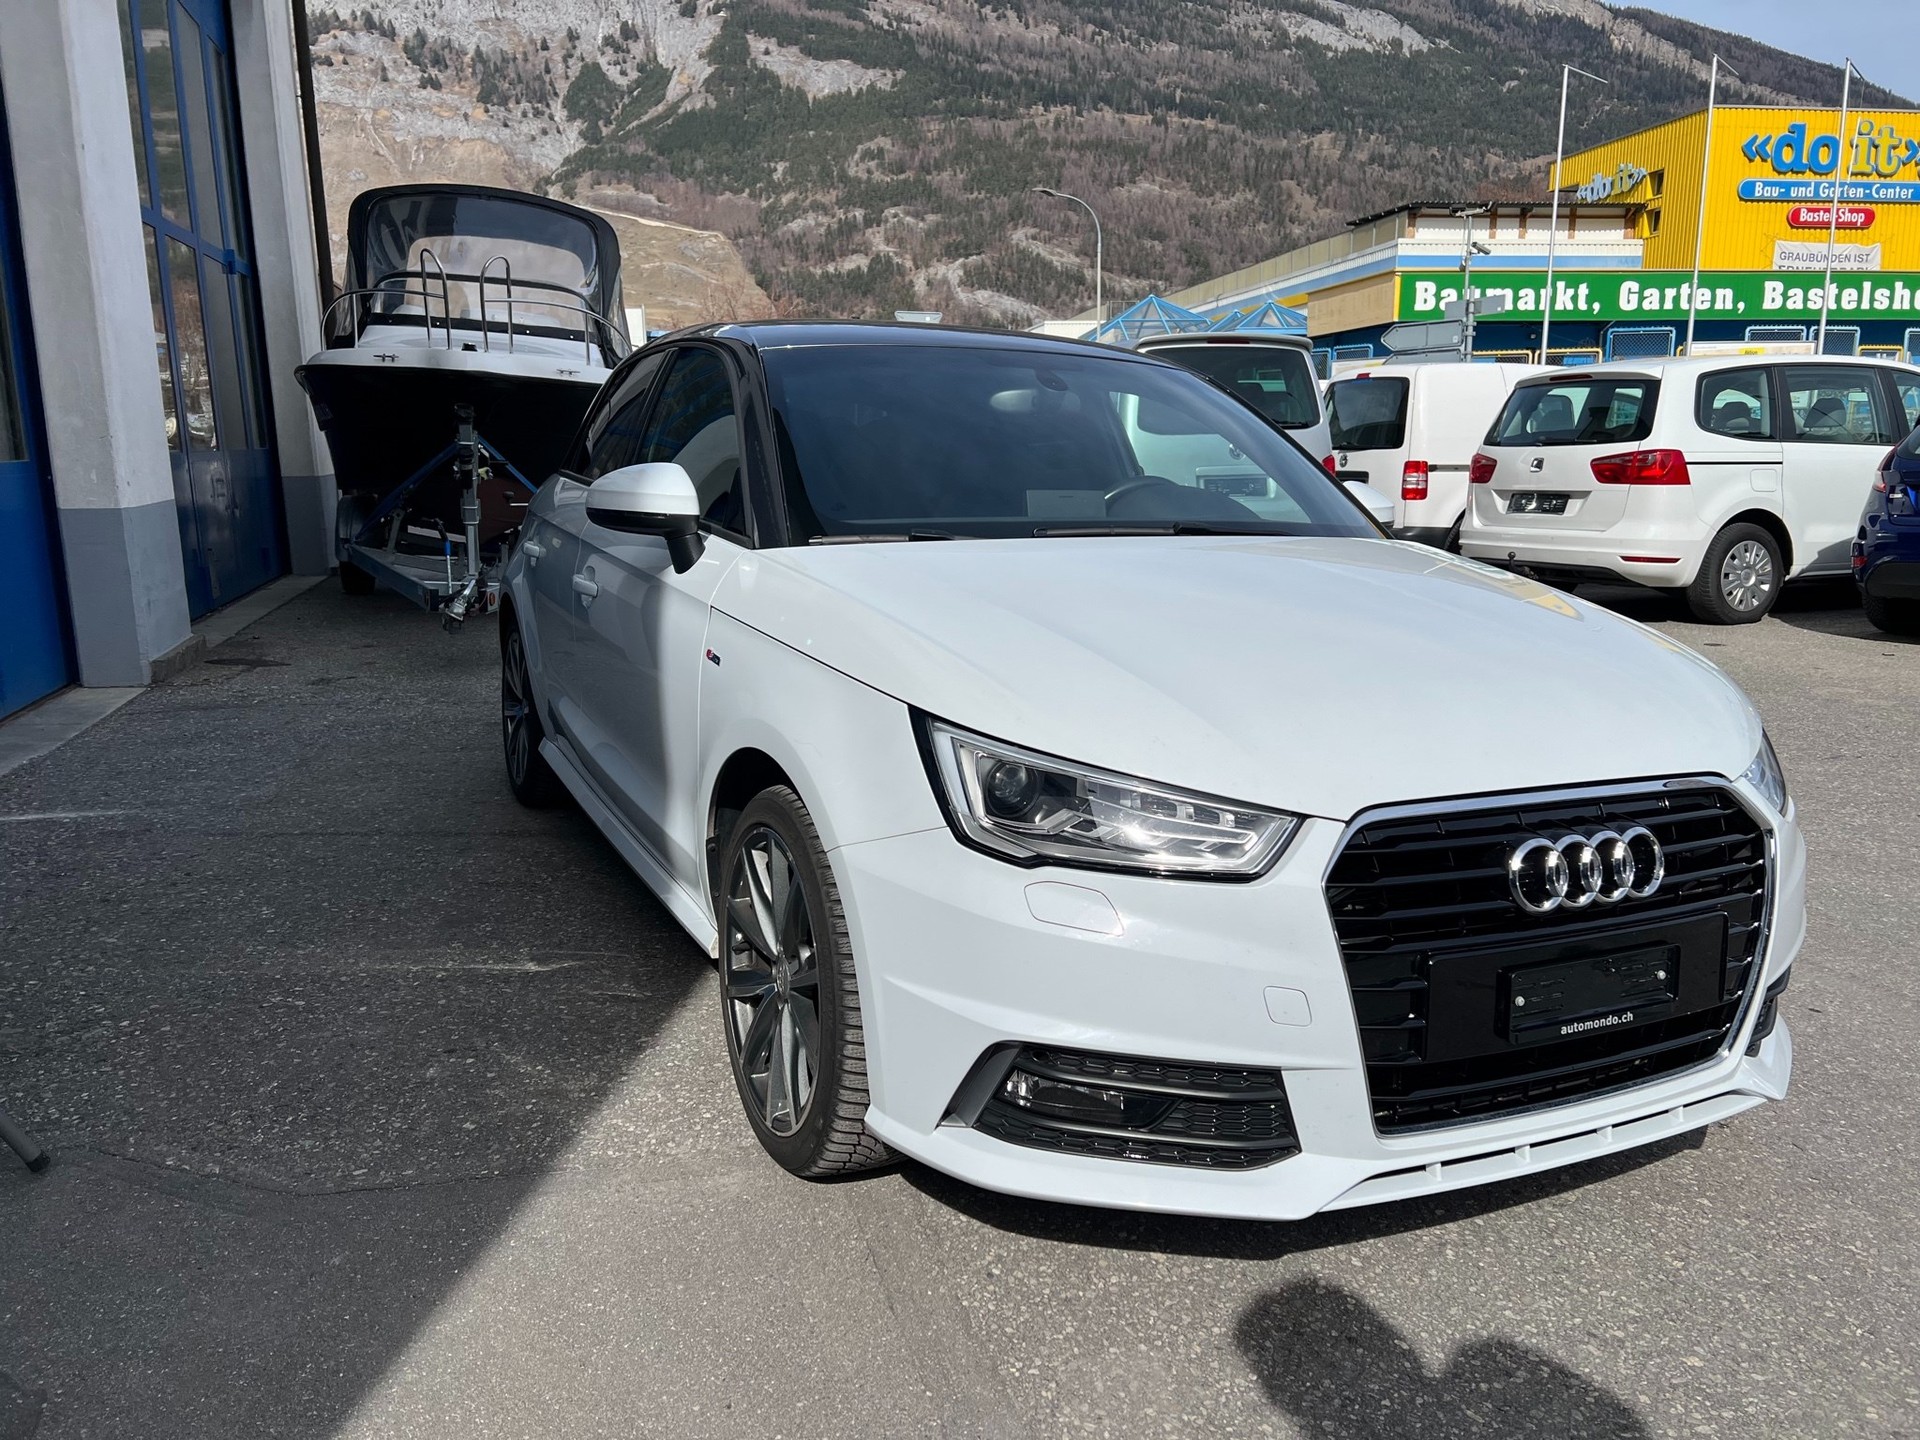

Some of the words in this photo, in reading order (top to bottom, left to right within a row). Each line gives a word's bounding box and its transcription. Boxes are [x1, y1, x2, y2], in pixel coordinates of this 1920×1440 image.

[1754, 181, 1786, 198] Bau-
[1790, 181, 1815, 198] und
[1779, 250, 1852, 264] GRAUBÜNDEN
[1853, 253, 1871, 264] IST
[1618, 280, 1746, 315] Garten,
[1560, 1011, 1634, 1035] automondo.ch
